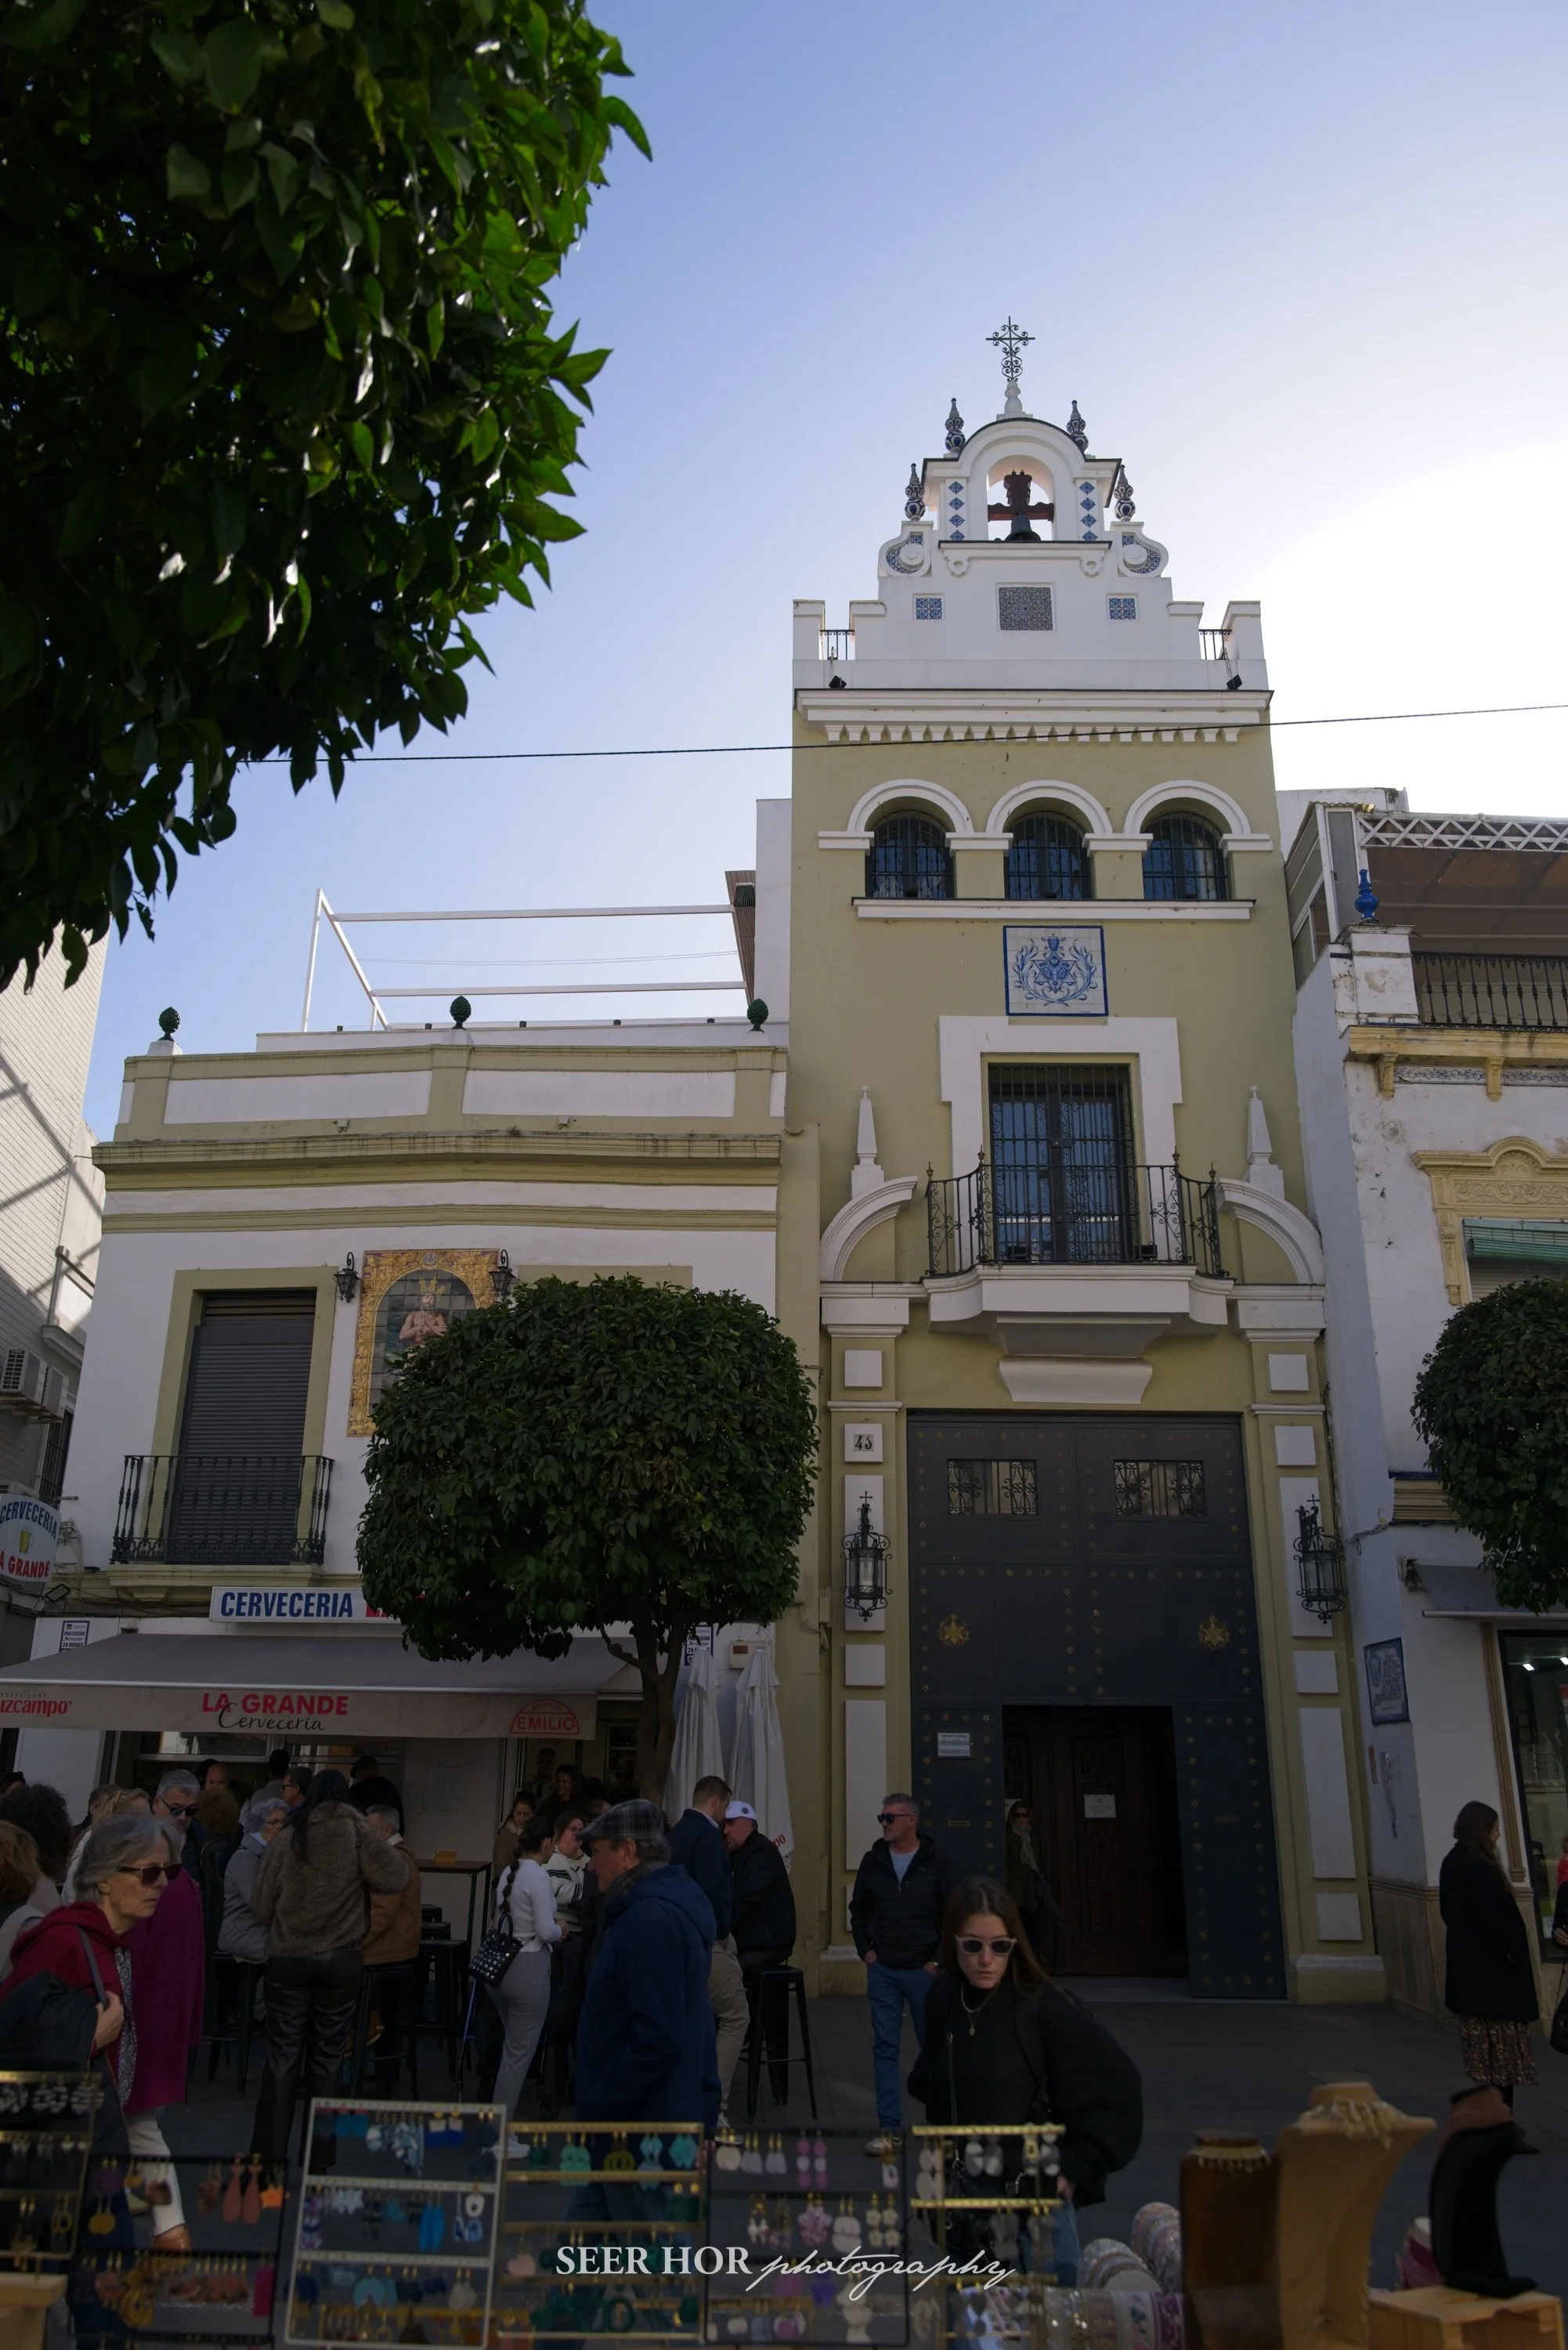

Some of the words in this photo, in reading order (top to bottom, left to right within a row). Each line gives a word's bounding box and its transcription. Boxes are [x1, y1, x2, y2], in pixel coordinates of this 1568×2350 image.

[0, 1501, 58, 1540] CERVECERIA
[8, 1555, 50, 1578] GRANDE
[221, 1592, 352, 1618] CERVECERIA
[202, 1693, 232, 1713] LA
[242, 1694, 349, 1716] GRANDE
[518, 1716, 575, 1730] EMILIO
